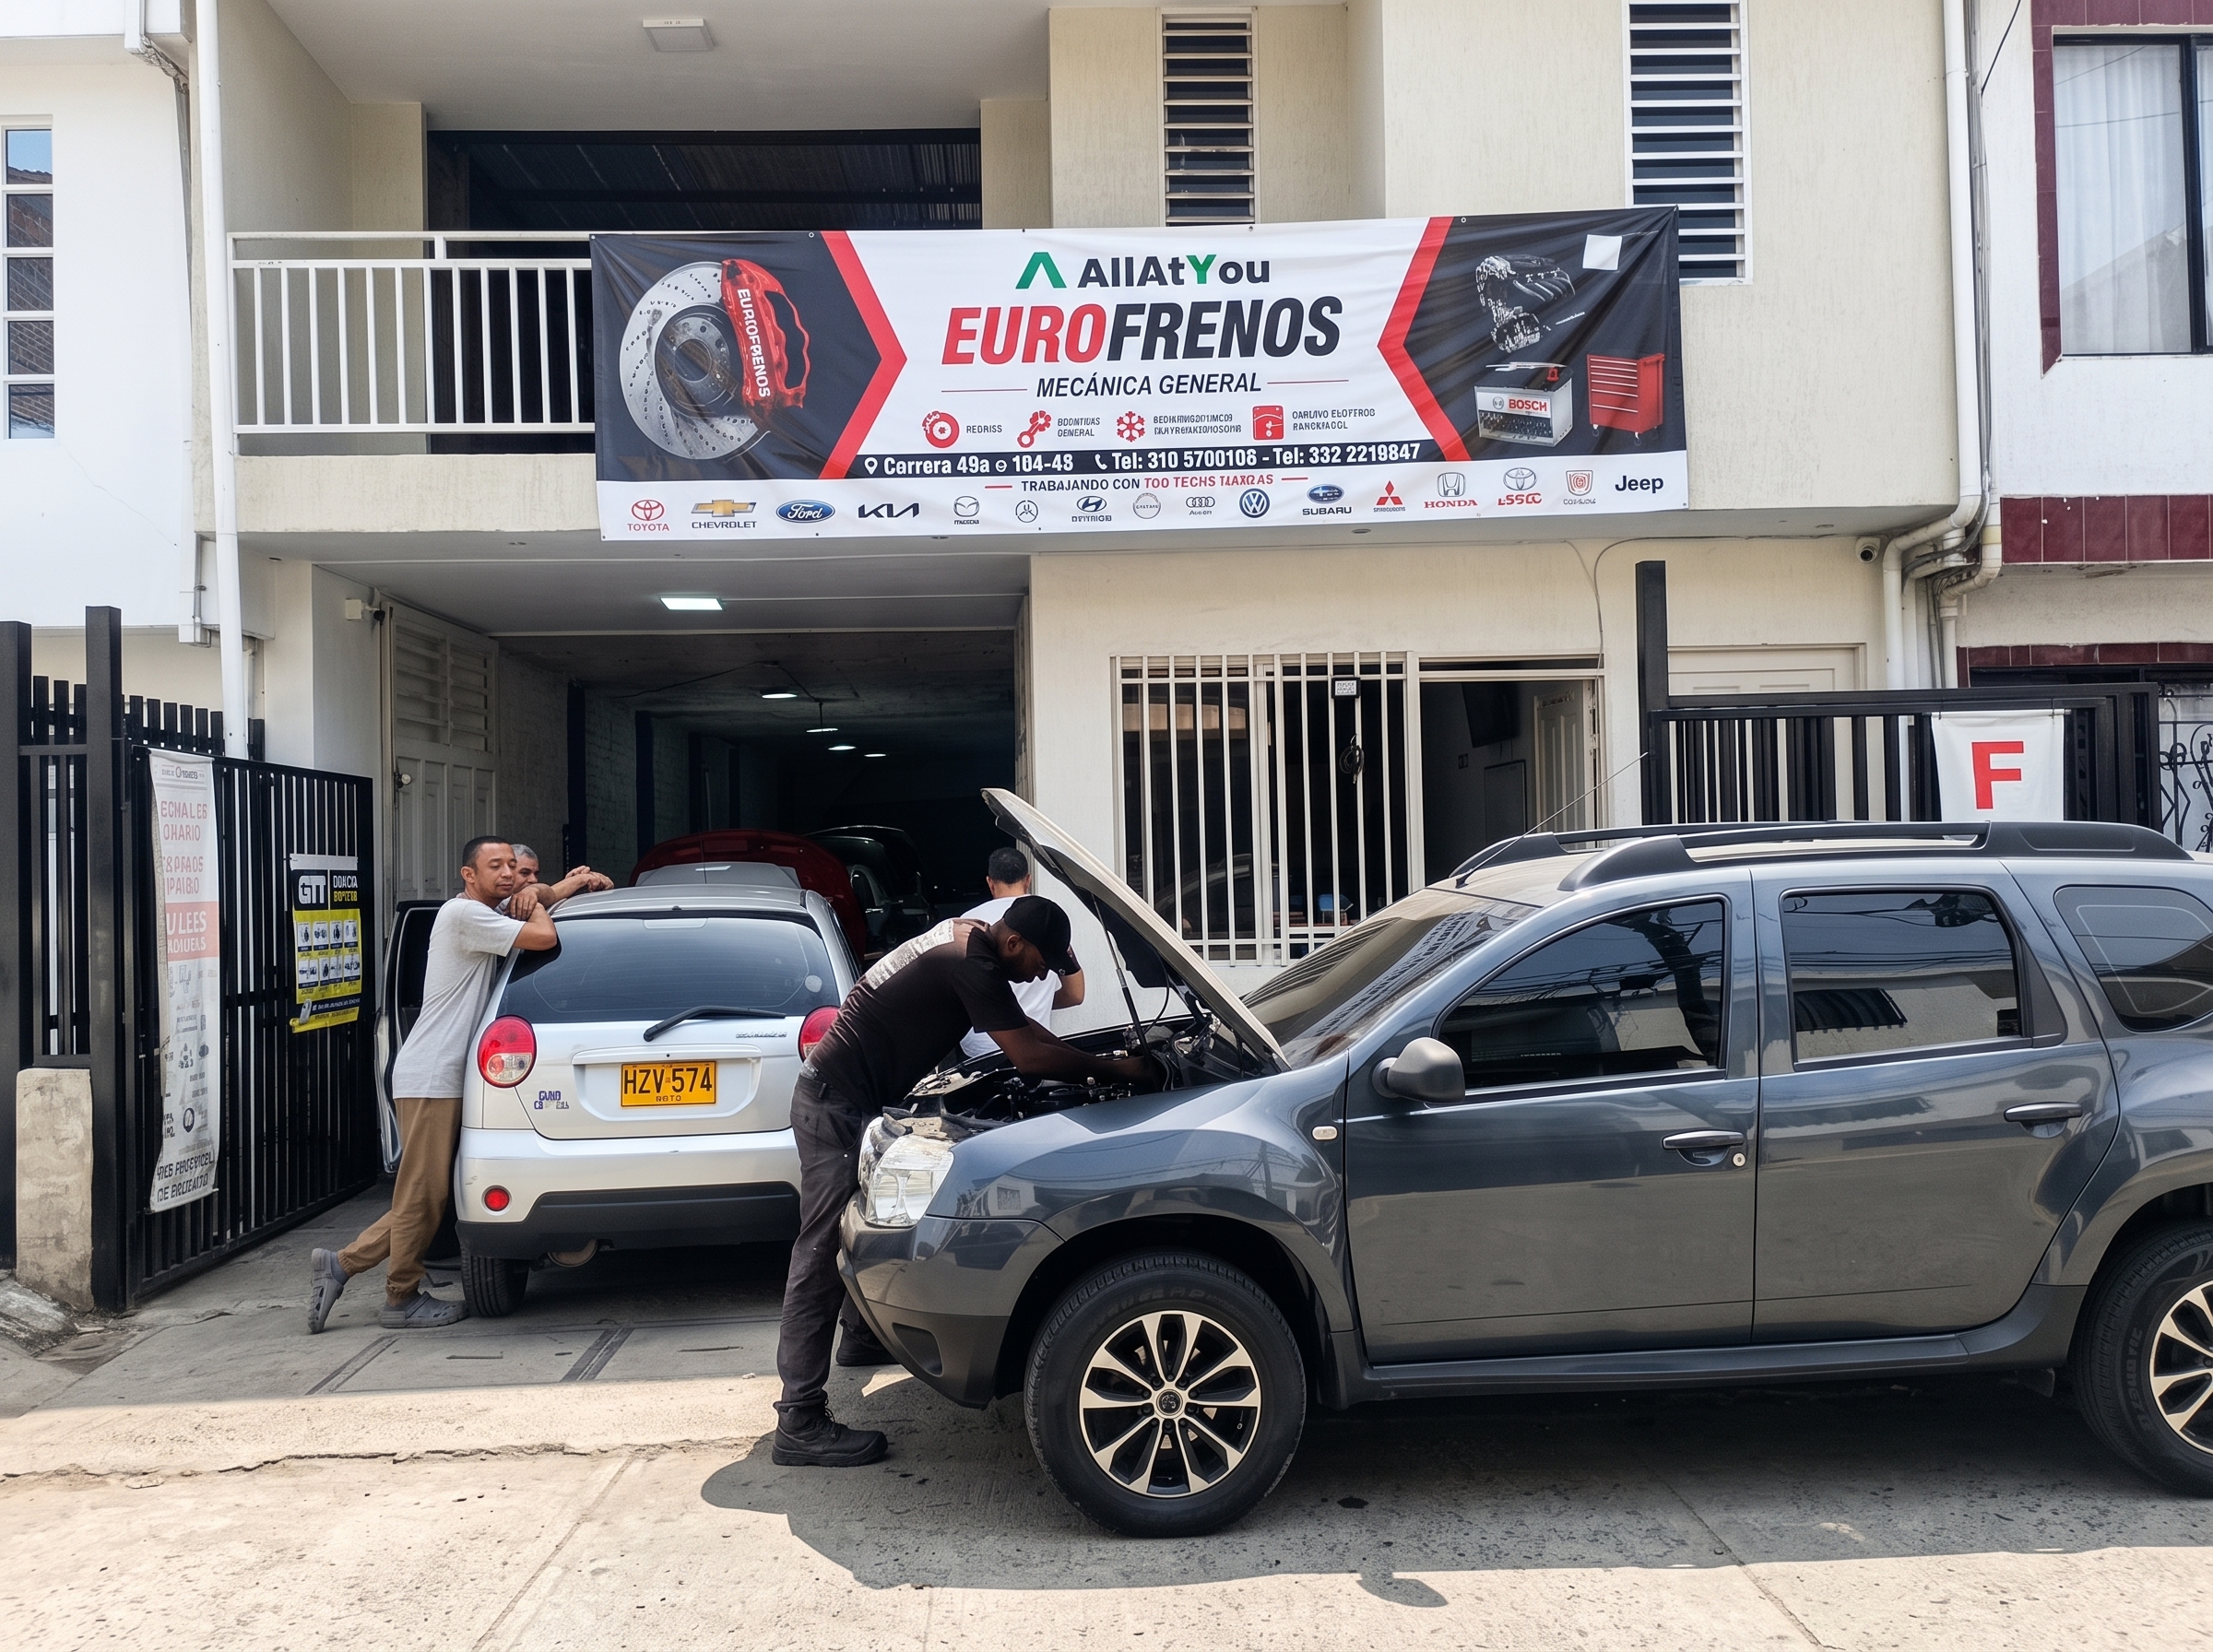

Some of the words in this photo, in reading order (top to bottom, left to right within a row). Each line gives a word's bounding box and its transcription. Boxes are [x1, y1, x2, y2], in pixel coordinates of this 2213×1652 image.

[1077, 253, 1270, 289] AllAtYou
[941, 295, 1343, 365] EUROFRENOS
[1036, 372, 1153, 398] MECÁNICA
[1159, 372, 1262, 395] GENERAL
[1509, 398, 1547, 412] BOSCH
[956, 455, 990, 474] 49a
[1012, 453, 1074, 472] 104-48
[1112, 452, 1143, 470] Tel:
[1147, 451, 1179, 469] 310
[1272, 447, 1305, 465] Tel:
[1308, 446, 1342, 464] 332
[1345, 442, 1421, 463] 2219847
[1021, 478, 1109, 491] TRABAJANDO
[1112, 478, 1140, 490] CON
[1143, 477, 1170, 489] TOO
[1173, 476, 1216, 488] TECHS
[1615, 475, 1664, 494] Jeep
[787, 504, 825, 521] Ford
[1302, 506, 1353, 515] SUBARU
[1424, 499, 1478, 509] HONDA
[627, 523, 670, 532] TOYOTA
[1970, 740, 2024, 810] F
[623, 1068, 666, 1095] HZV
[671, 1067, 713, 1093] 574
